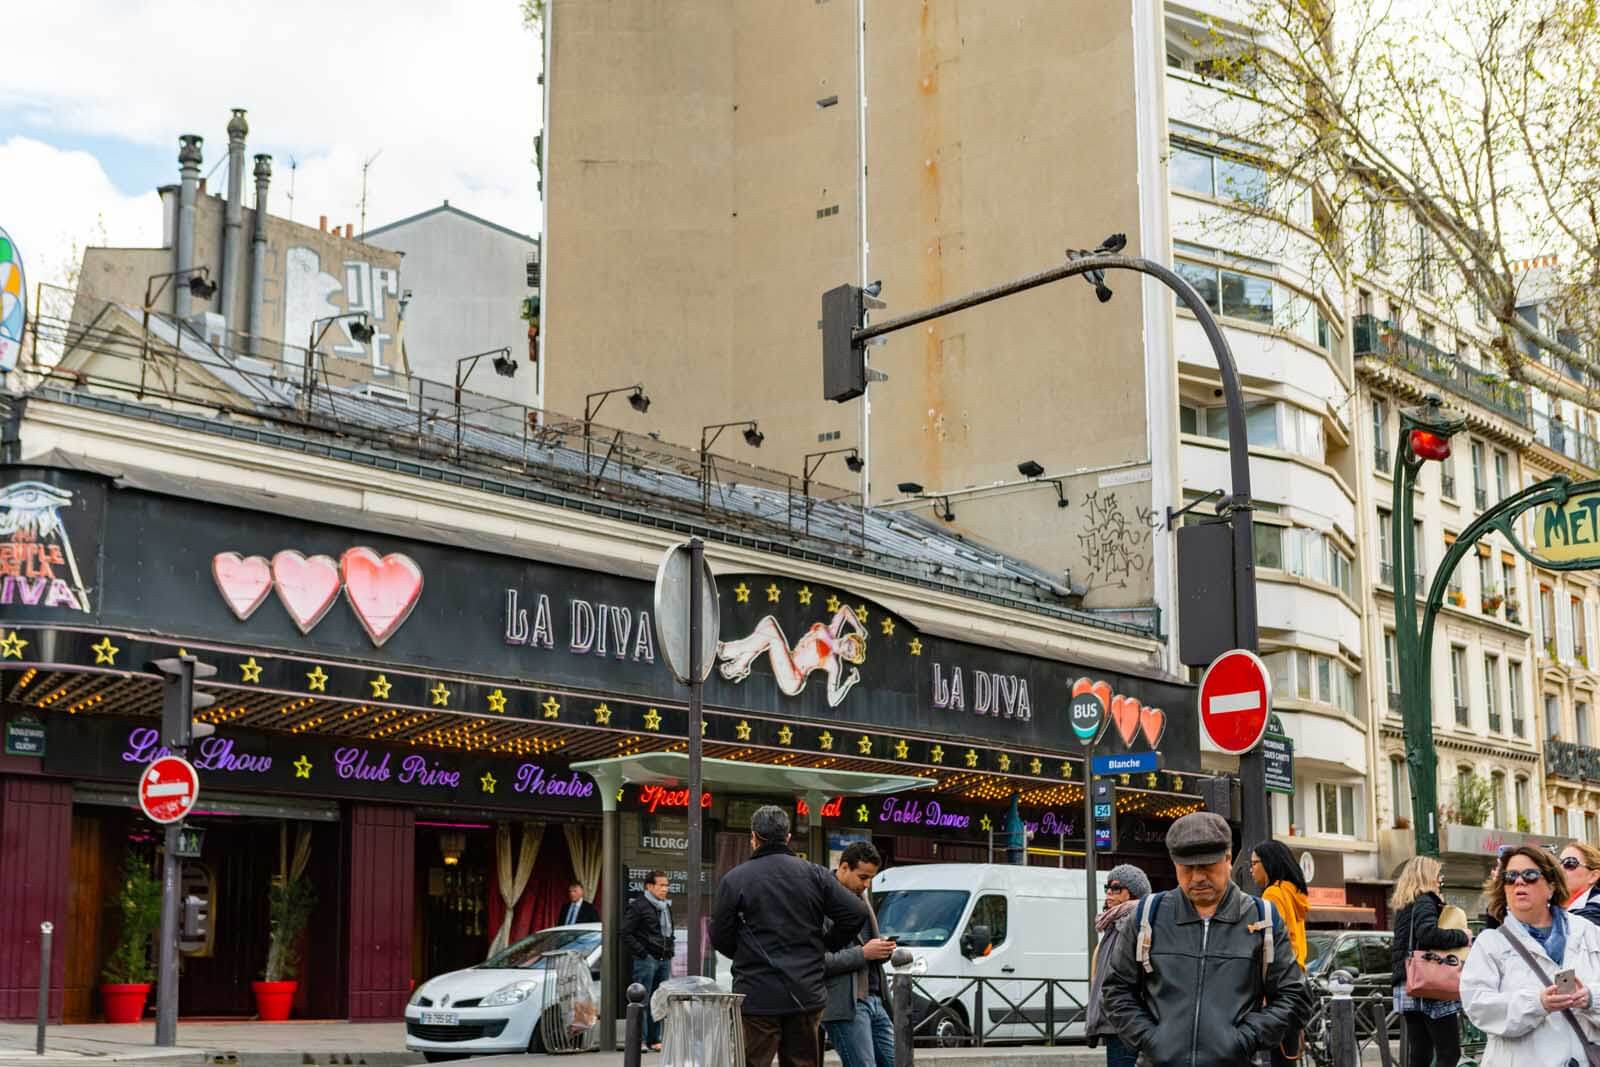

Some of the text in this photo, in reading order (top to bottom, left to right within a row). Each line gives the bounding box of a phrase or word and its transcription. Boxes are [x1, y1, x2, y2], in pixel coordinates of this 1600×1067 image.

[0, 576, 82, 610] IVA
[505, 588, 655, 664] LA DIVA
[932, 663, 1032, 721] LA DIVA
[1073, 702, 1098, 719] BUS
[193, 737, 273, 772] Show
[334, 747, 461, 788] Club Prive
[1108, 758, 1141, 769] Blanche
[879, 797, 971, 829] Table Dance
[1097, 806, 1109, 816] 54
[629, 868, 651, 880] EFFE
